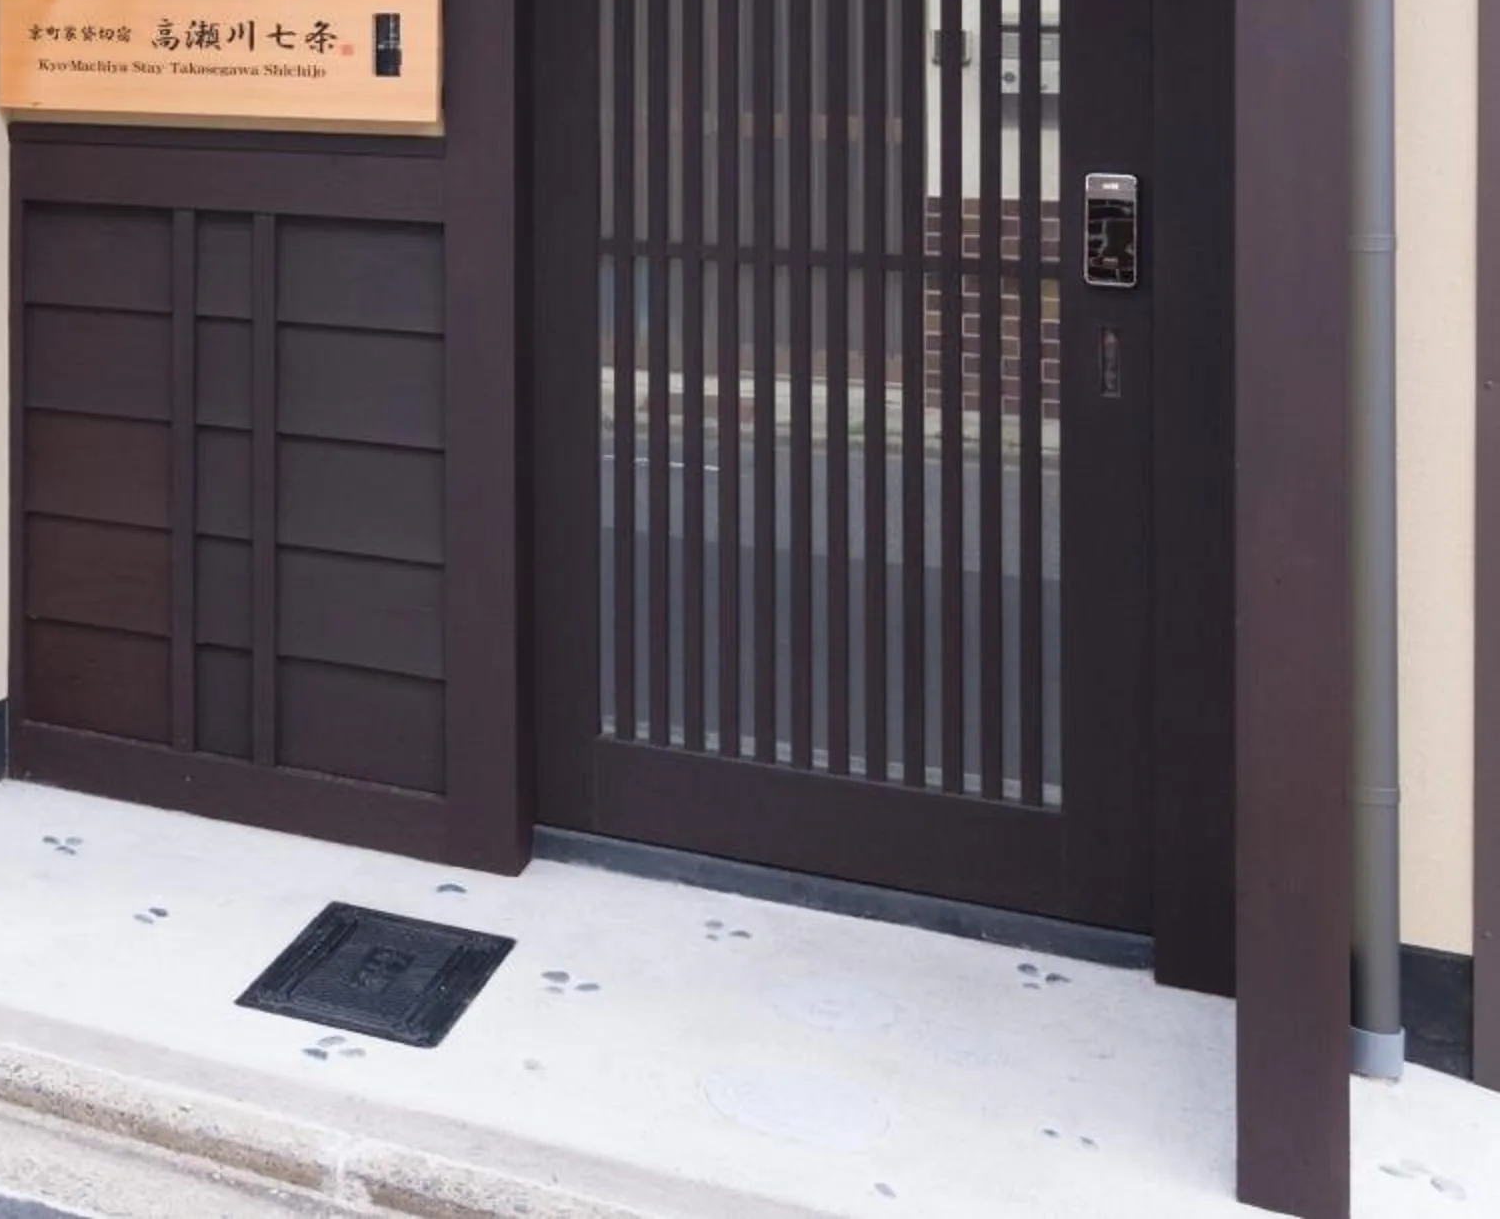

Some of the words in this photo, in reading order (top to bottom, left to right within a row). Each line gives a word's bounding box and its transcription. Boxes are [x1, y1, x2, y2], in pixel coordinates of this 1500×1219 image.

[132, 60, 165, 75] Stay
[170, 62, 259, 77] Takasegawa
[263, 64, 328, 79] Shichijo
